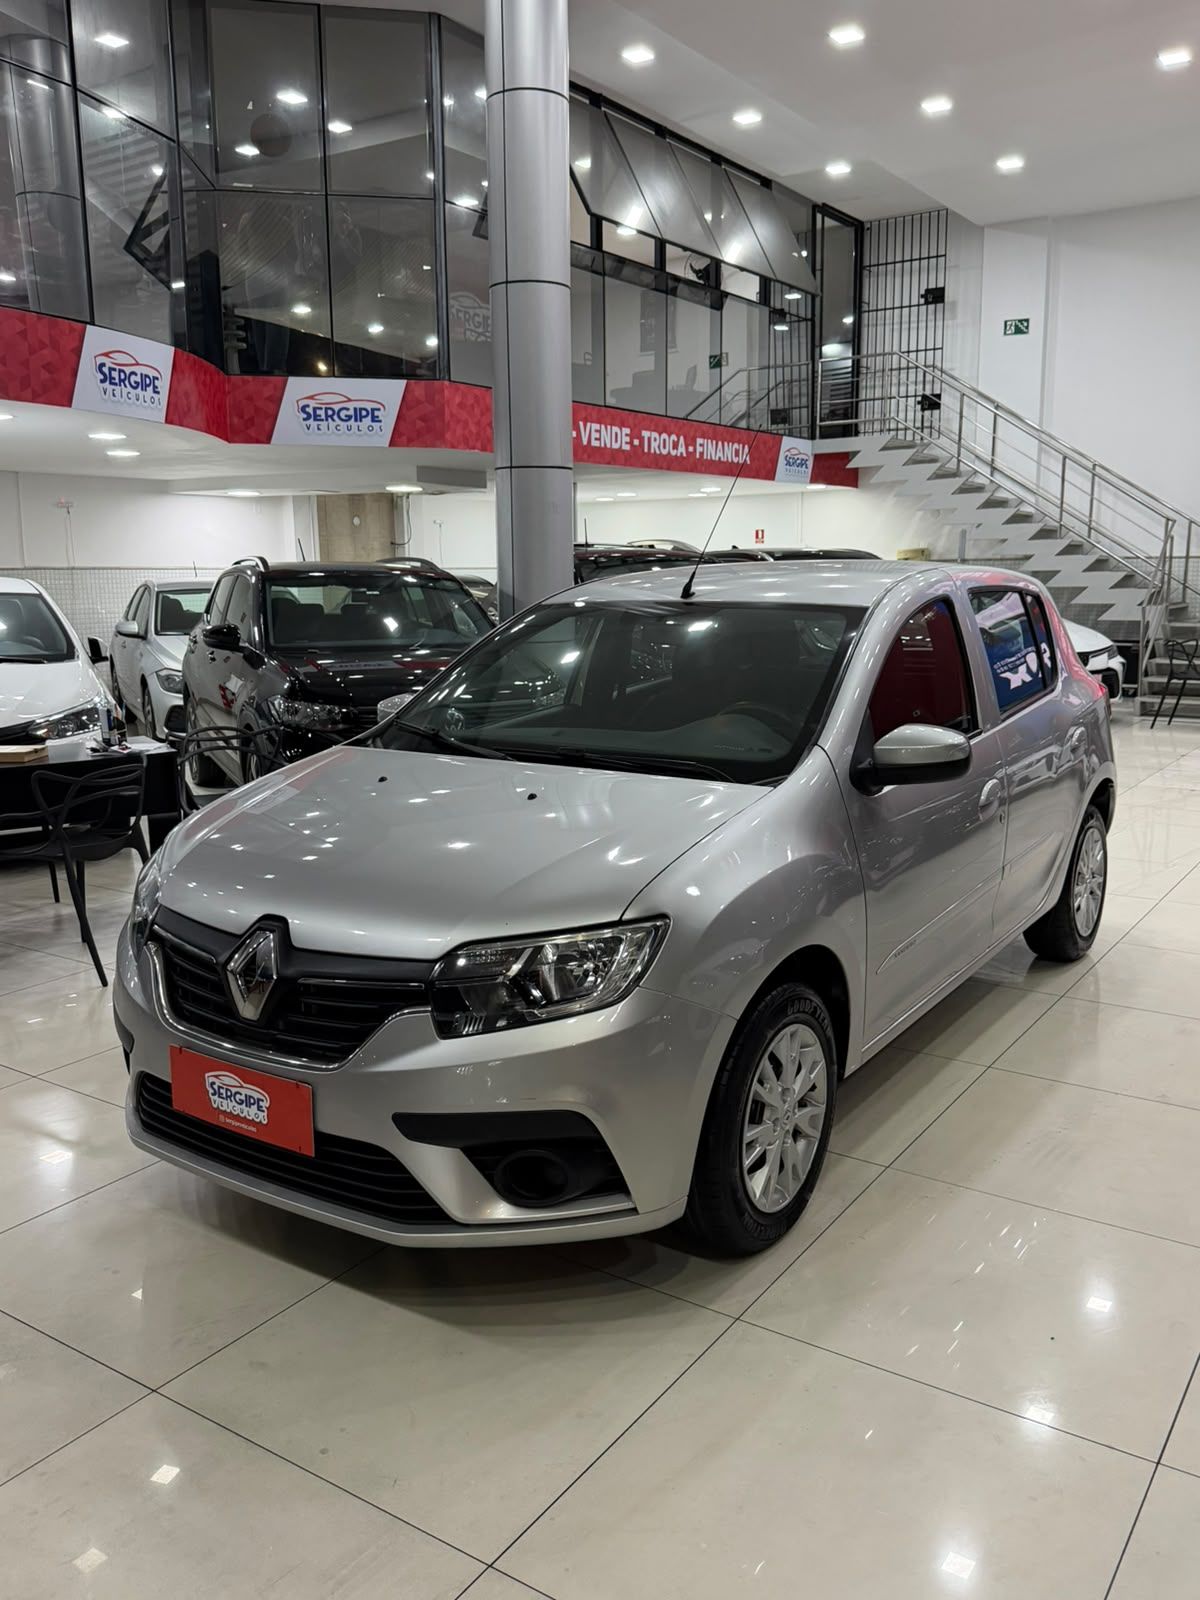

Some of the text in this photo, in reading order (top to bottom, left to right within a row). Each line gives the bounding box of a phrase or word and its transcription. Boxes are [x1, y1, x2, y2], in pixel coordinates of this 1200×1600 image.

[98, 361, 160, 395] SERGIPE
[102, 386, 161, 405] VEÍCULOS
[300, 404, 382, 423] SERGIPE
[305, 423, 383, 432] VEÍCULOS
[579, 421, 631, 451] VENDE
[641, 430, 687, 457] TROCA
[696, 438, 751, 464] FINANCIA
[210, 1082, 265, 1112] SERGIPE
